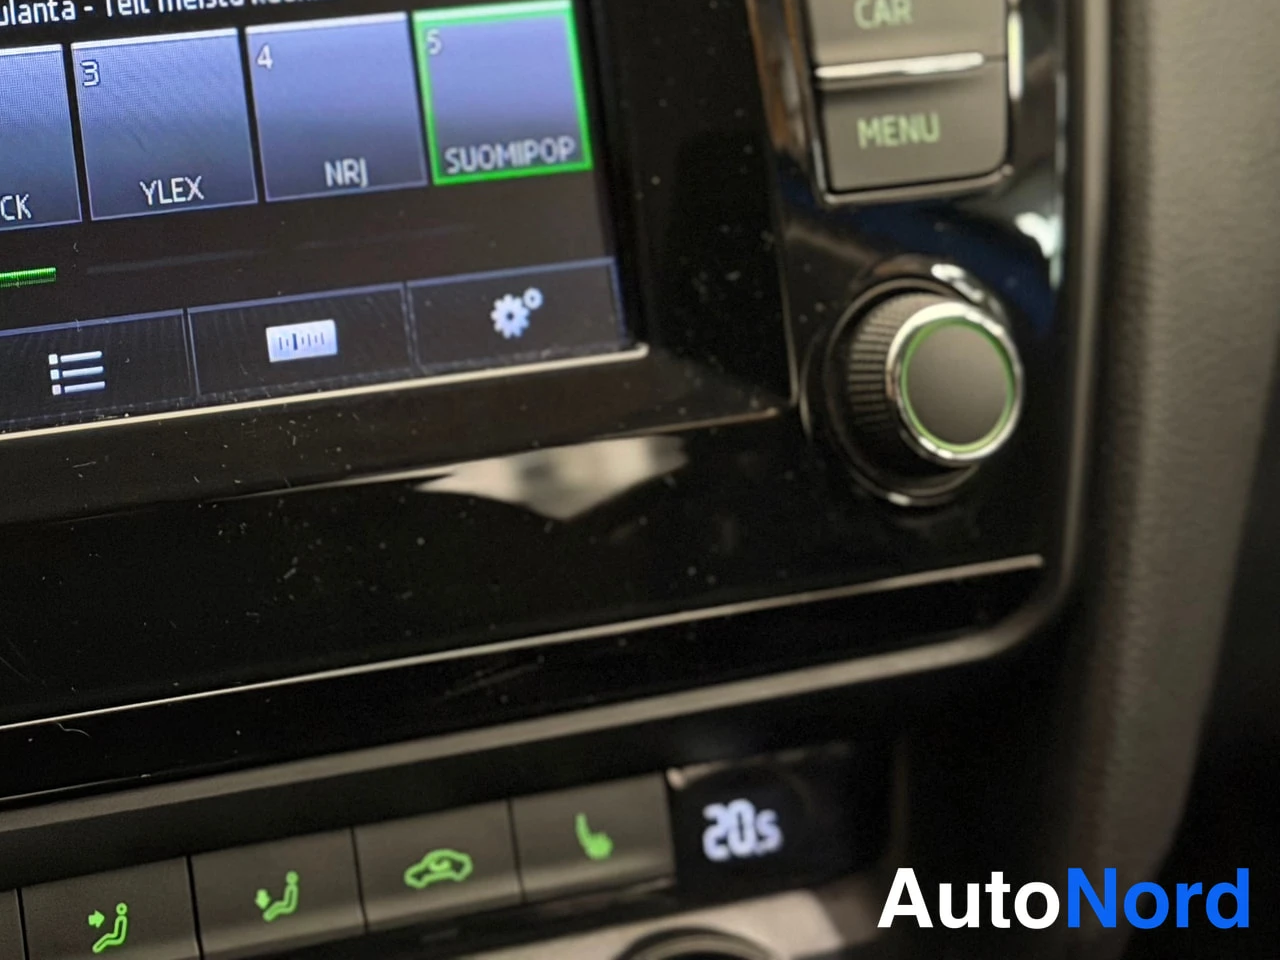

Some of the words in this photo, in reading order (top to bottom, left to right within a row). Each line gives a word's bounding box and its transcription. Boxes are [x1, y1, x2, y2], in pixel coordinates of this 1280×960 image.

[256, 44, 273, 71] 4
[425, 29, 443, 55] 5
[81, 59, 101, 87] 3
[856, 112, 941, 149] MENU
[444, 135, 577, 175] SUOMIPOP
[325, 157, 369, 188] NRJ
[140, 175, 205, 207] YLEX
